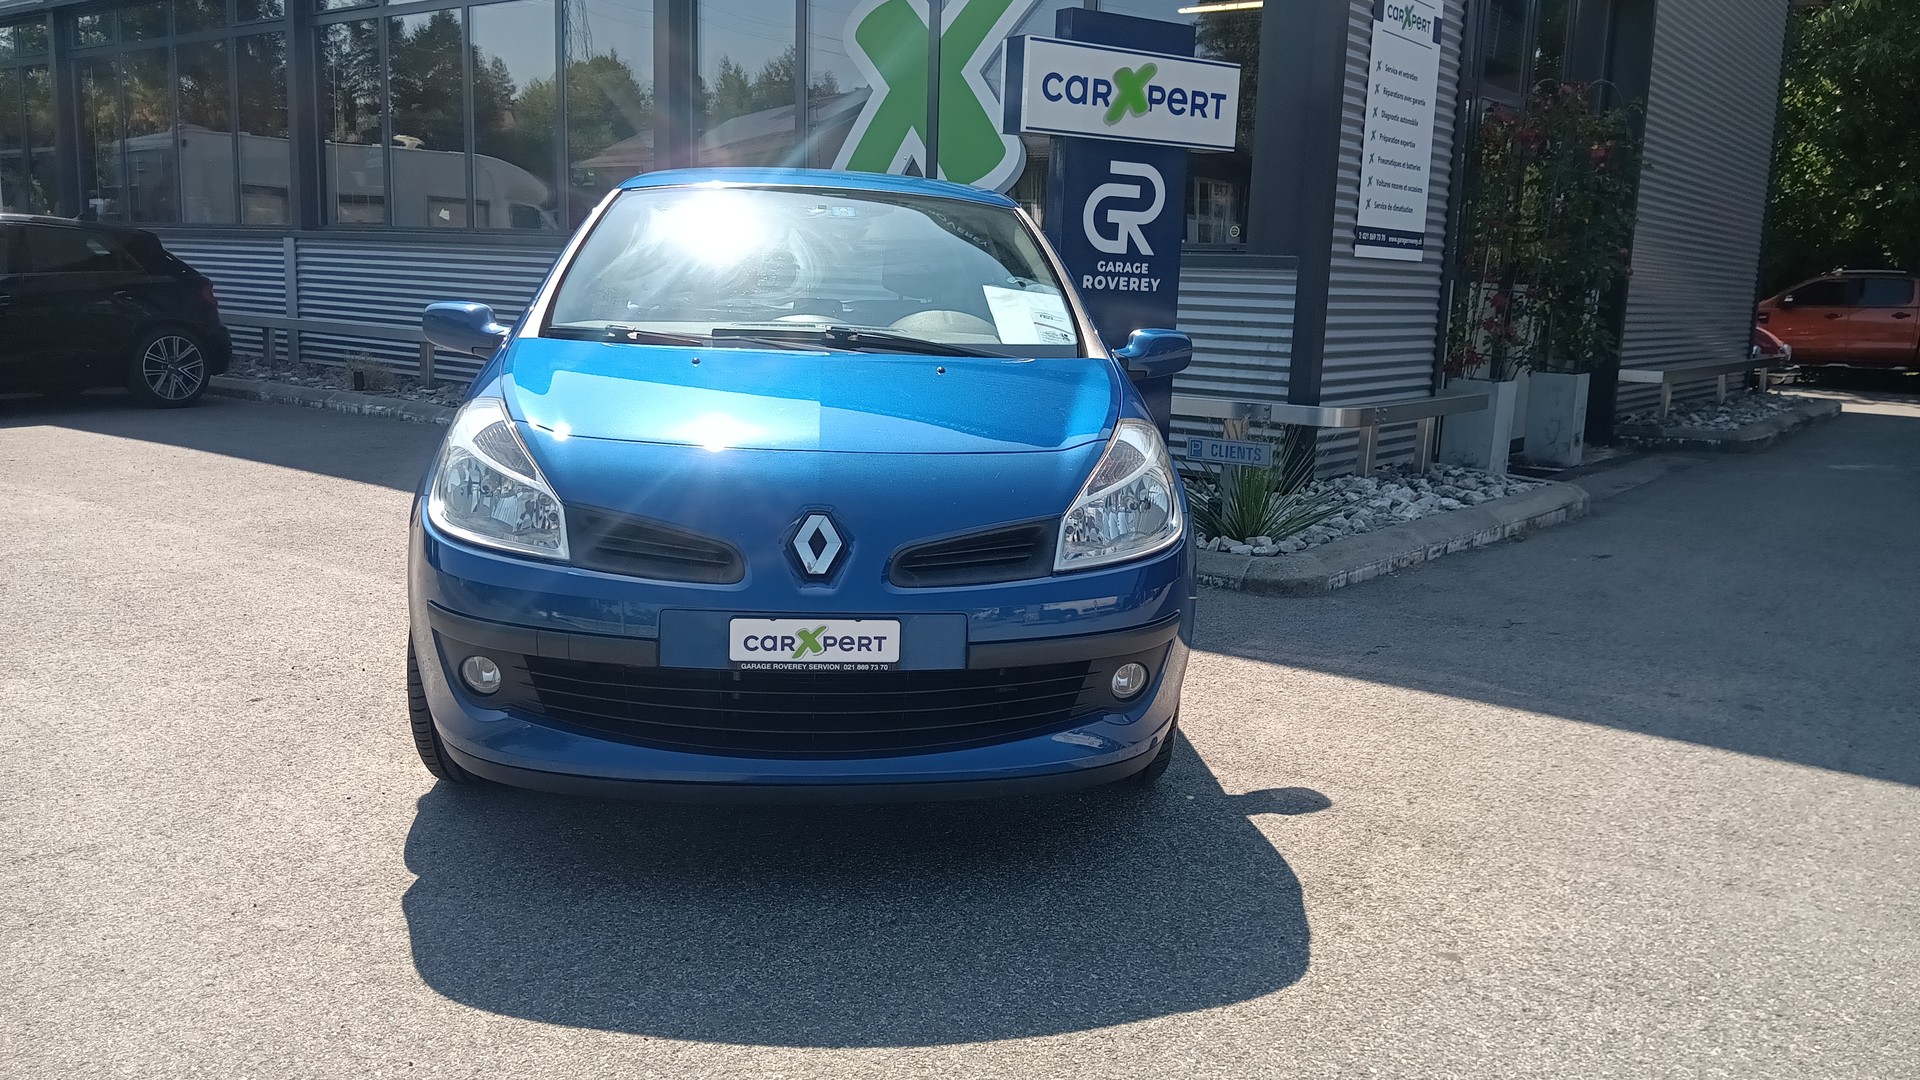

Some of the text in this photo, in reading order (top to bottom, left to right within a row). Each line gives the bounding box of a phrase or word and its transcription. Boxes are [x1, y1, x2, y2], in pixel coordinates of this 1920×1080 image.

[1385, 63, 1398, 75] Service
[1381, 110, 1400, 121] Diagnostic
[1374, 200, 1387, 210] Service
[1097, 260, 1149, 275] GARAGE
[1082, 275, 1160, 292] ROVEREY
[1192, 441, 1262, 461] P CLIENTS
